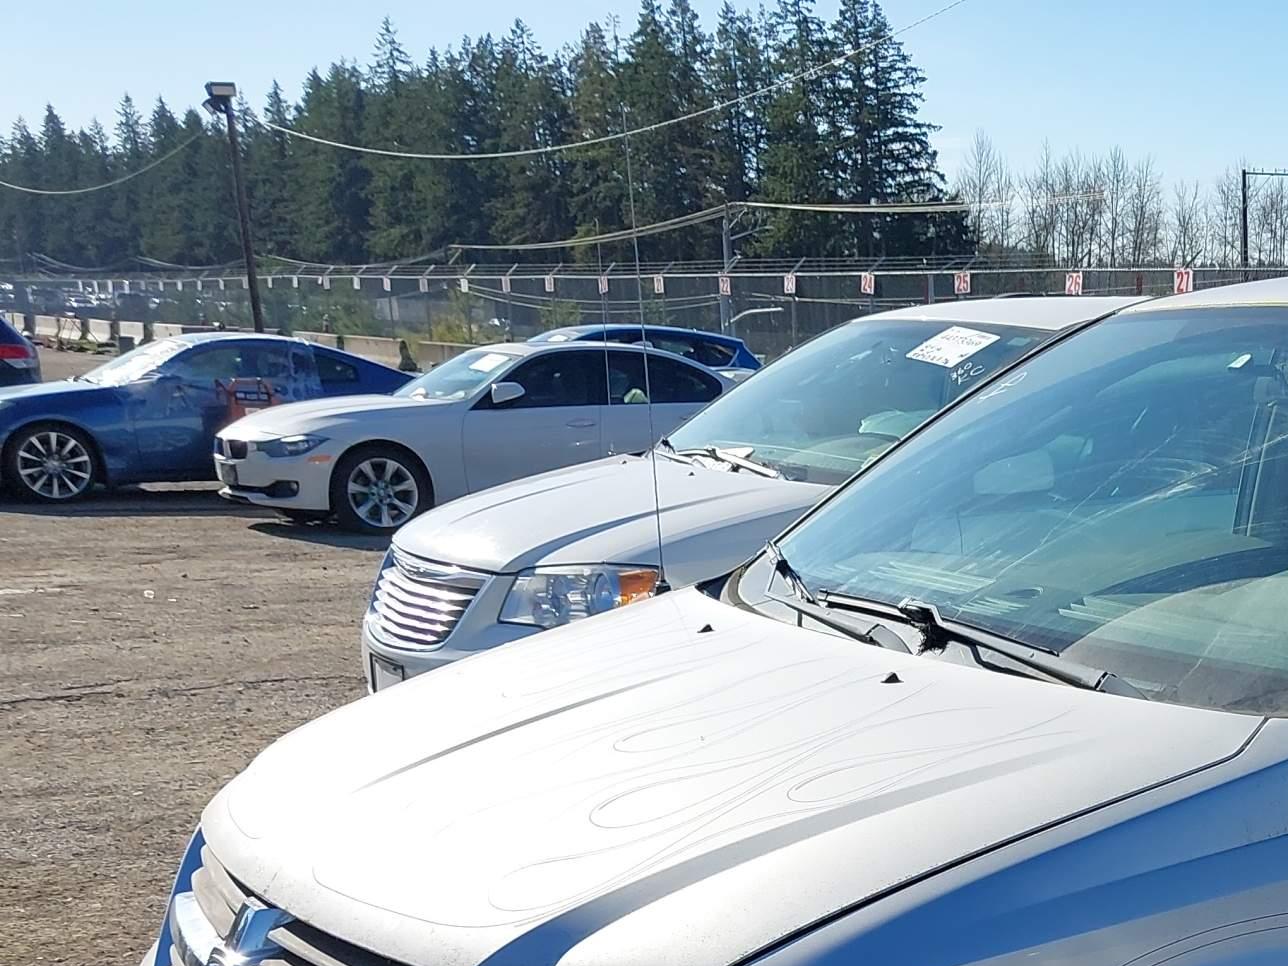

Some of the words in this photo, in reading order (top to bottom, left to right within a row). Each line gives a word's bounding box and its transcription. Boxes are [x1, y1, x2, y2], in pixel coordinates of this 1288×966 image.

[720, 277, 730, 293] 22
[862, 275, 873, 293] 24
[956, 274, 969, 293] 25
[1067, 274, 1081, 295] 26
[1176, 270, 1190, 293] 27
